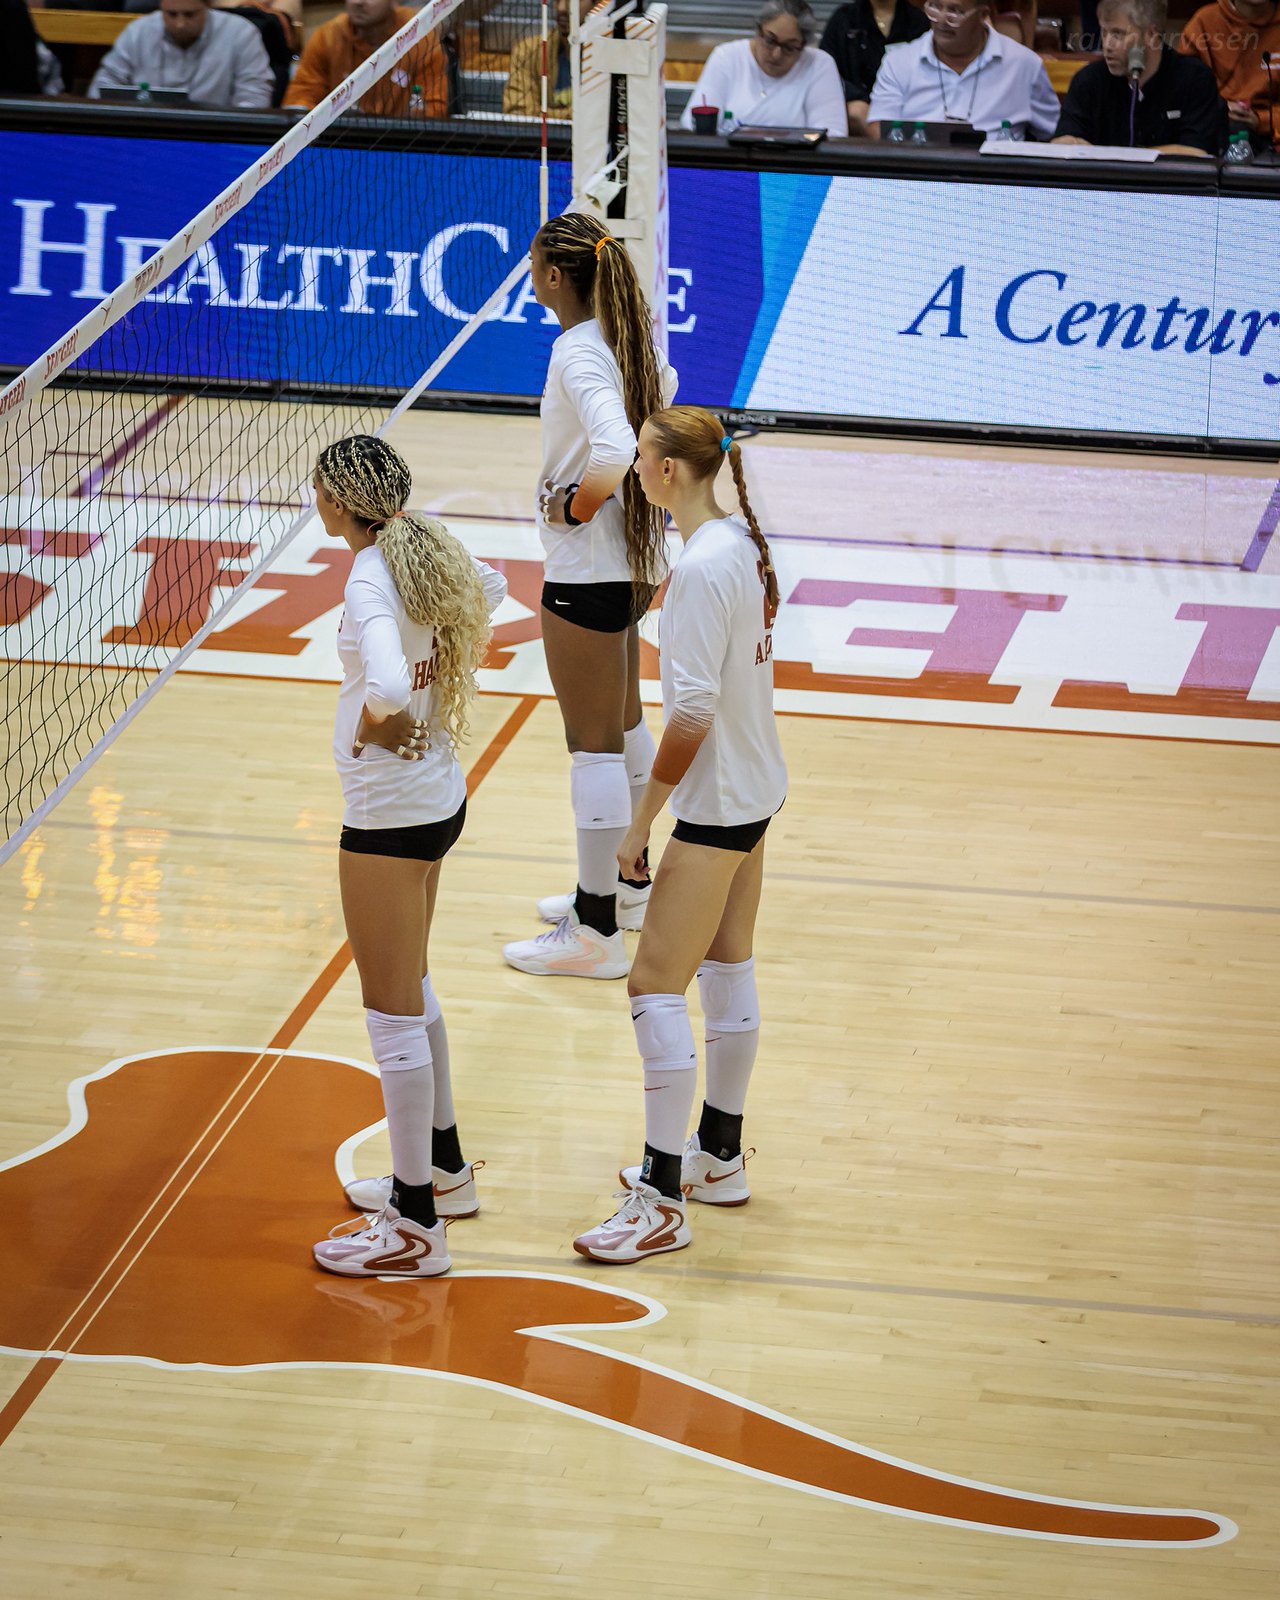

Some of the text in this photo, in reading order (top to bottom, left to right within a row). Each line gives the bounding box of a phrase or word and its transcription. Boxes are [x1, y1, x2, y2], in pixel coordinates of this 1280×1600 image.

[9, 198, 697, 333] HEALTHCAE
[898, 265, 1280, 386] A Centur
